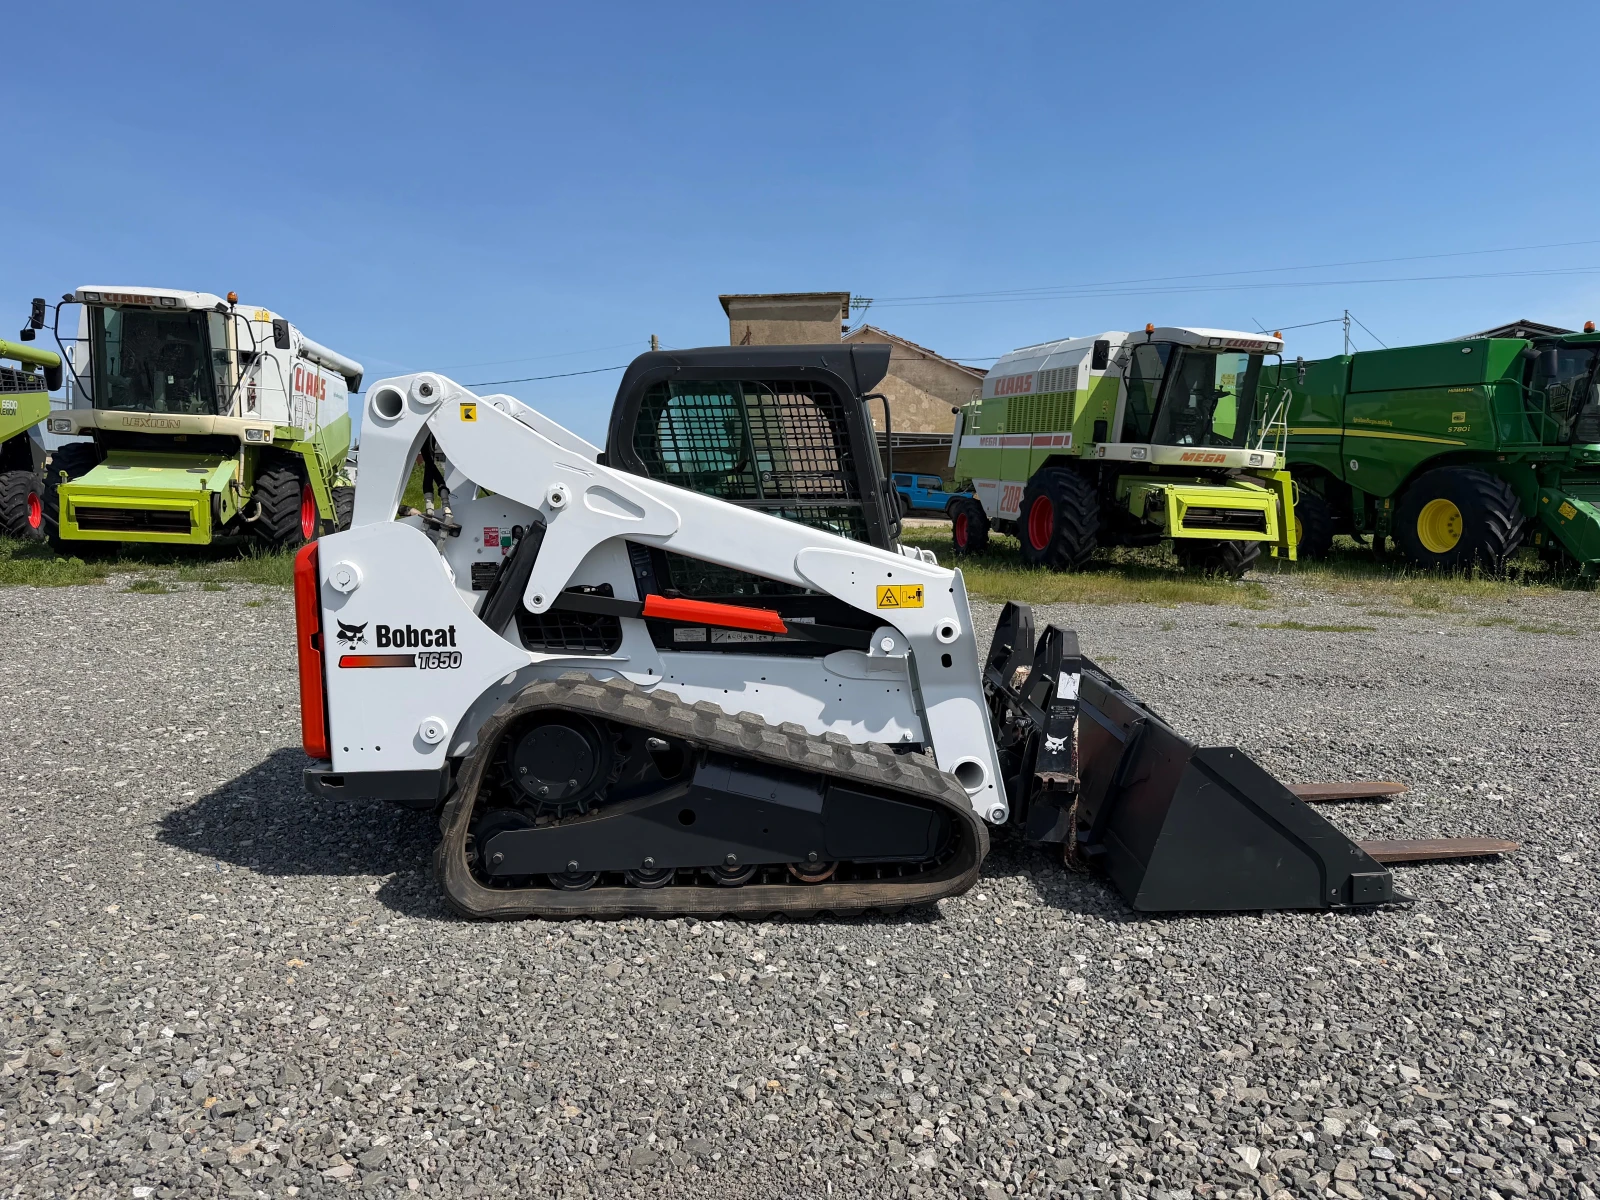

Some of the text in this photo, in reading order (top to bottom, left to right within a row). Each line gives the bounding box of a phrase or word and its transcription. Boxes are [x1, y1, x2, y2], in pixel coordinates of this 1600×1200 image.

[103, 293, 155, 304] CLAAS
[1225, 339, 1264, 348] CLAAS
[994, 375, 1032, 395] CLAAS
[122, 417, 180, 428] LEXION
[979, 437, 998, 446] MEGA
[1180, 452, 1226, 463] MEGA
[376, 624, 457, 648] Bobcat
[418, 651, 462, 670] T650
